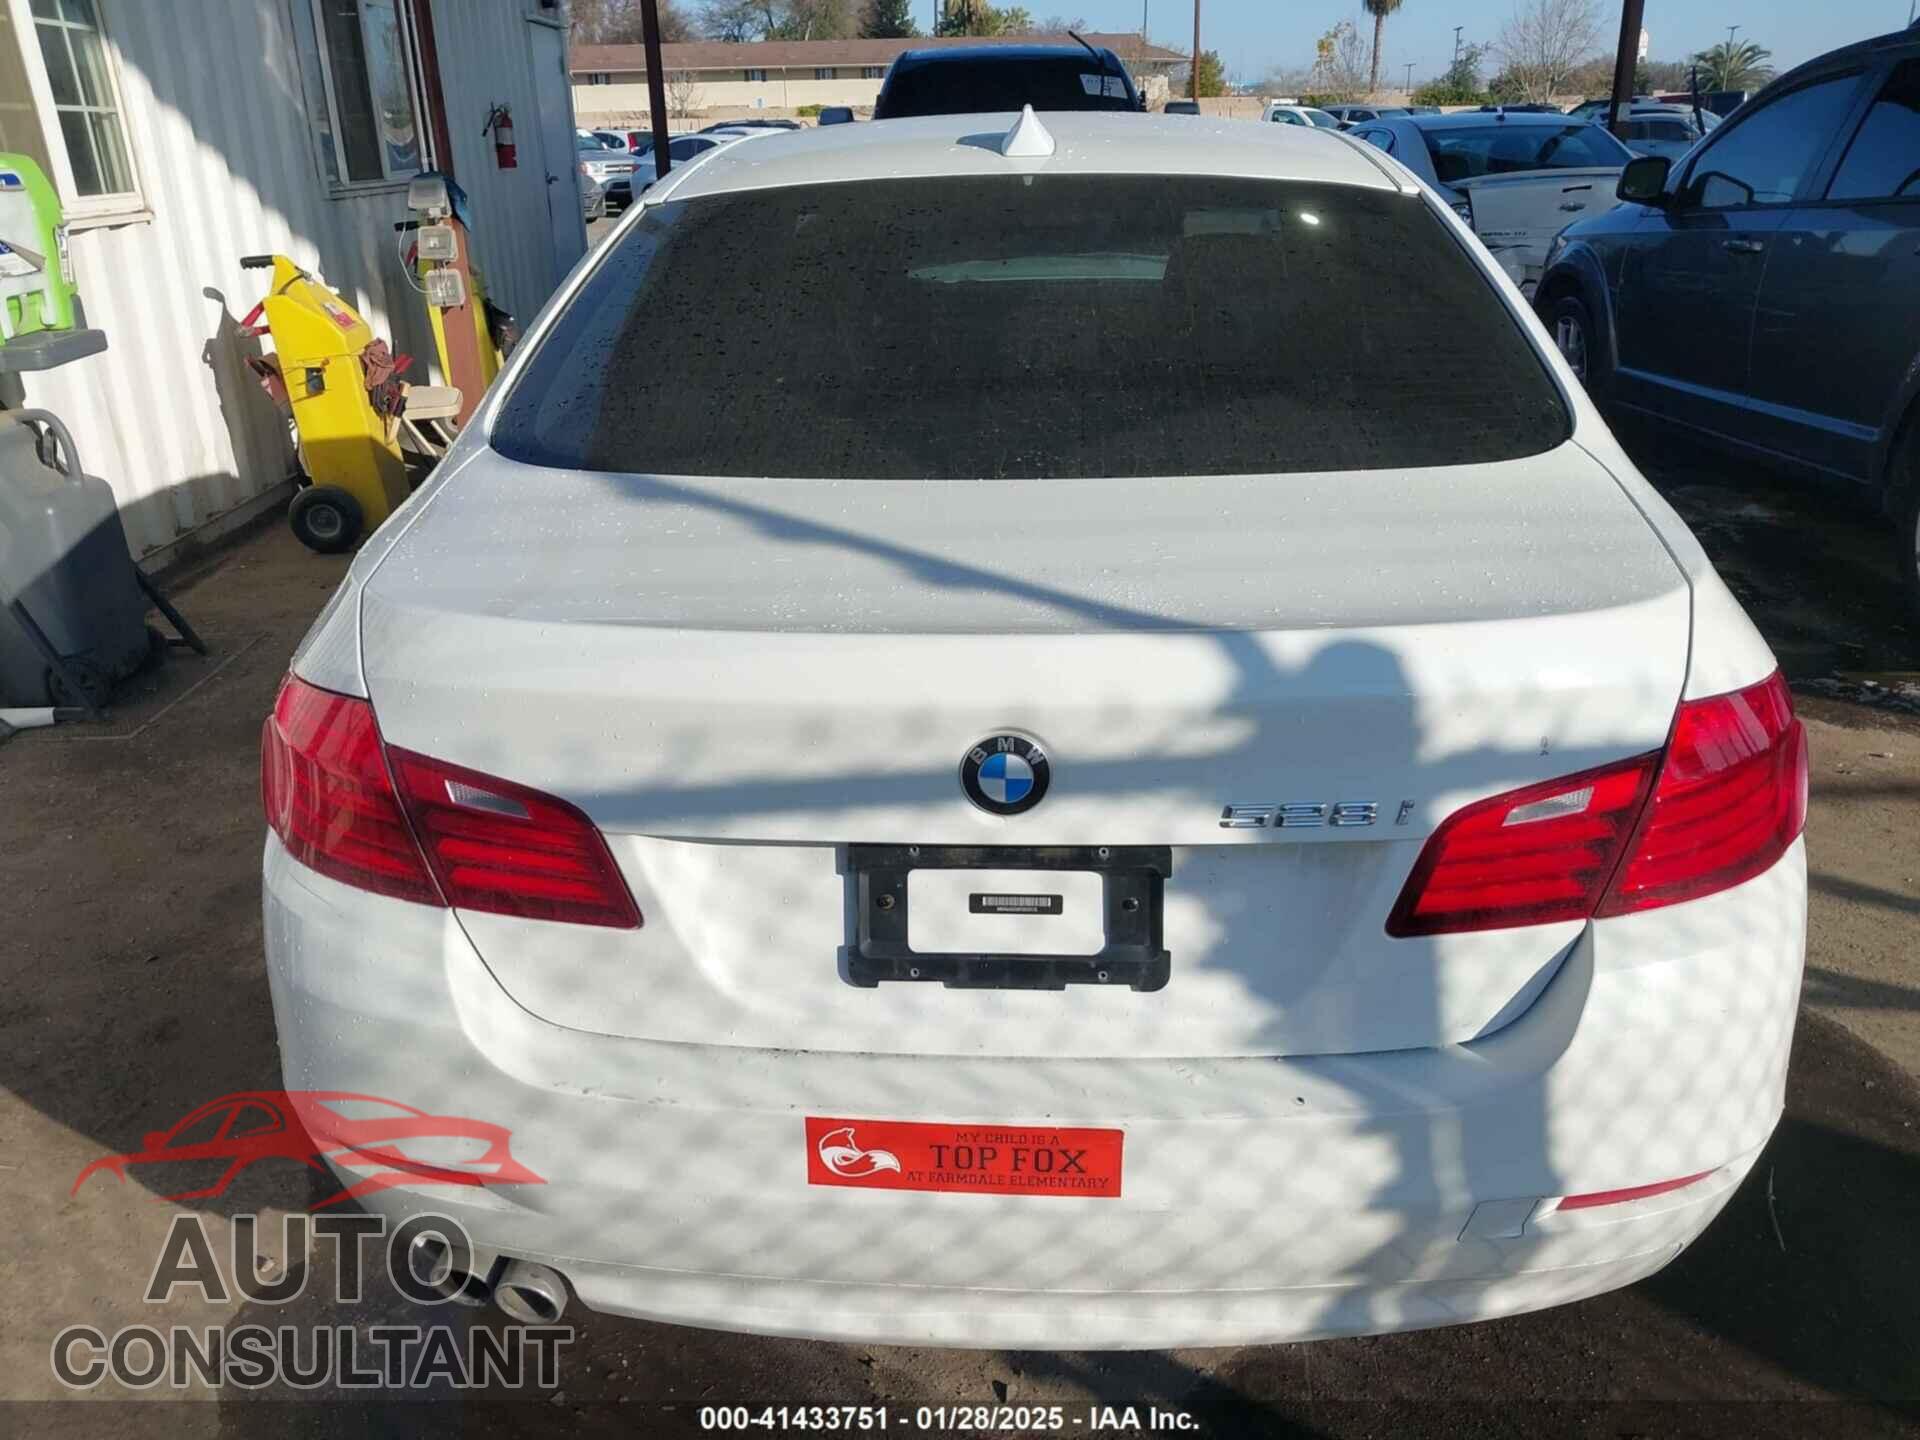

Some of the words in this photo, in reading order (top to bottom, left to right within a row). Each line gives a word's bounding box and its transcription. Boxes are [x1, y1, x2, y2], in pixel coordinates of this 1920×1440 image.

[968, 737, 1045, 766] BMW
[956, 1132, 980, 1142] MY
[985, 1133, 1027, 1145] CHILD
[1032, 1136, 1045, 1145] IS
[1050, 1136, 1060, 1146] A
[929, 1145, 997, 1170] TOP
[1012, 1148, 1087, 1174] FOX
[907, 1171, 924, 1181] AT
[929, 1171, 1005, 1186] FARMDALE
[1009, 1175, 1109, 1189] ELEMENTARY
